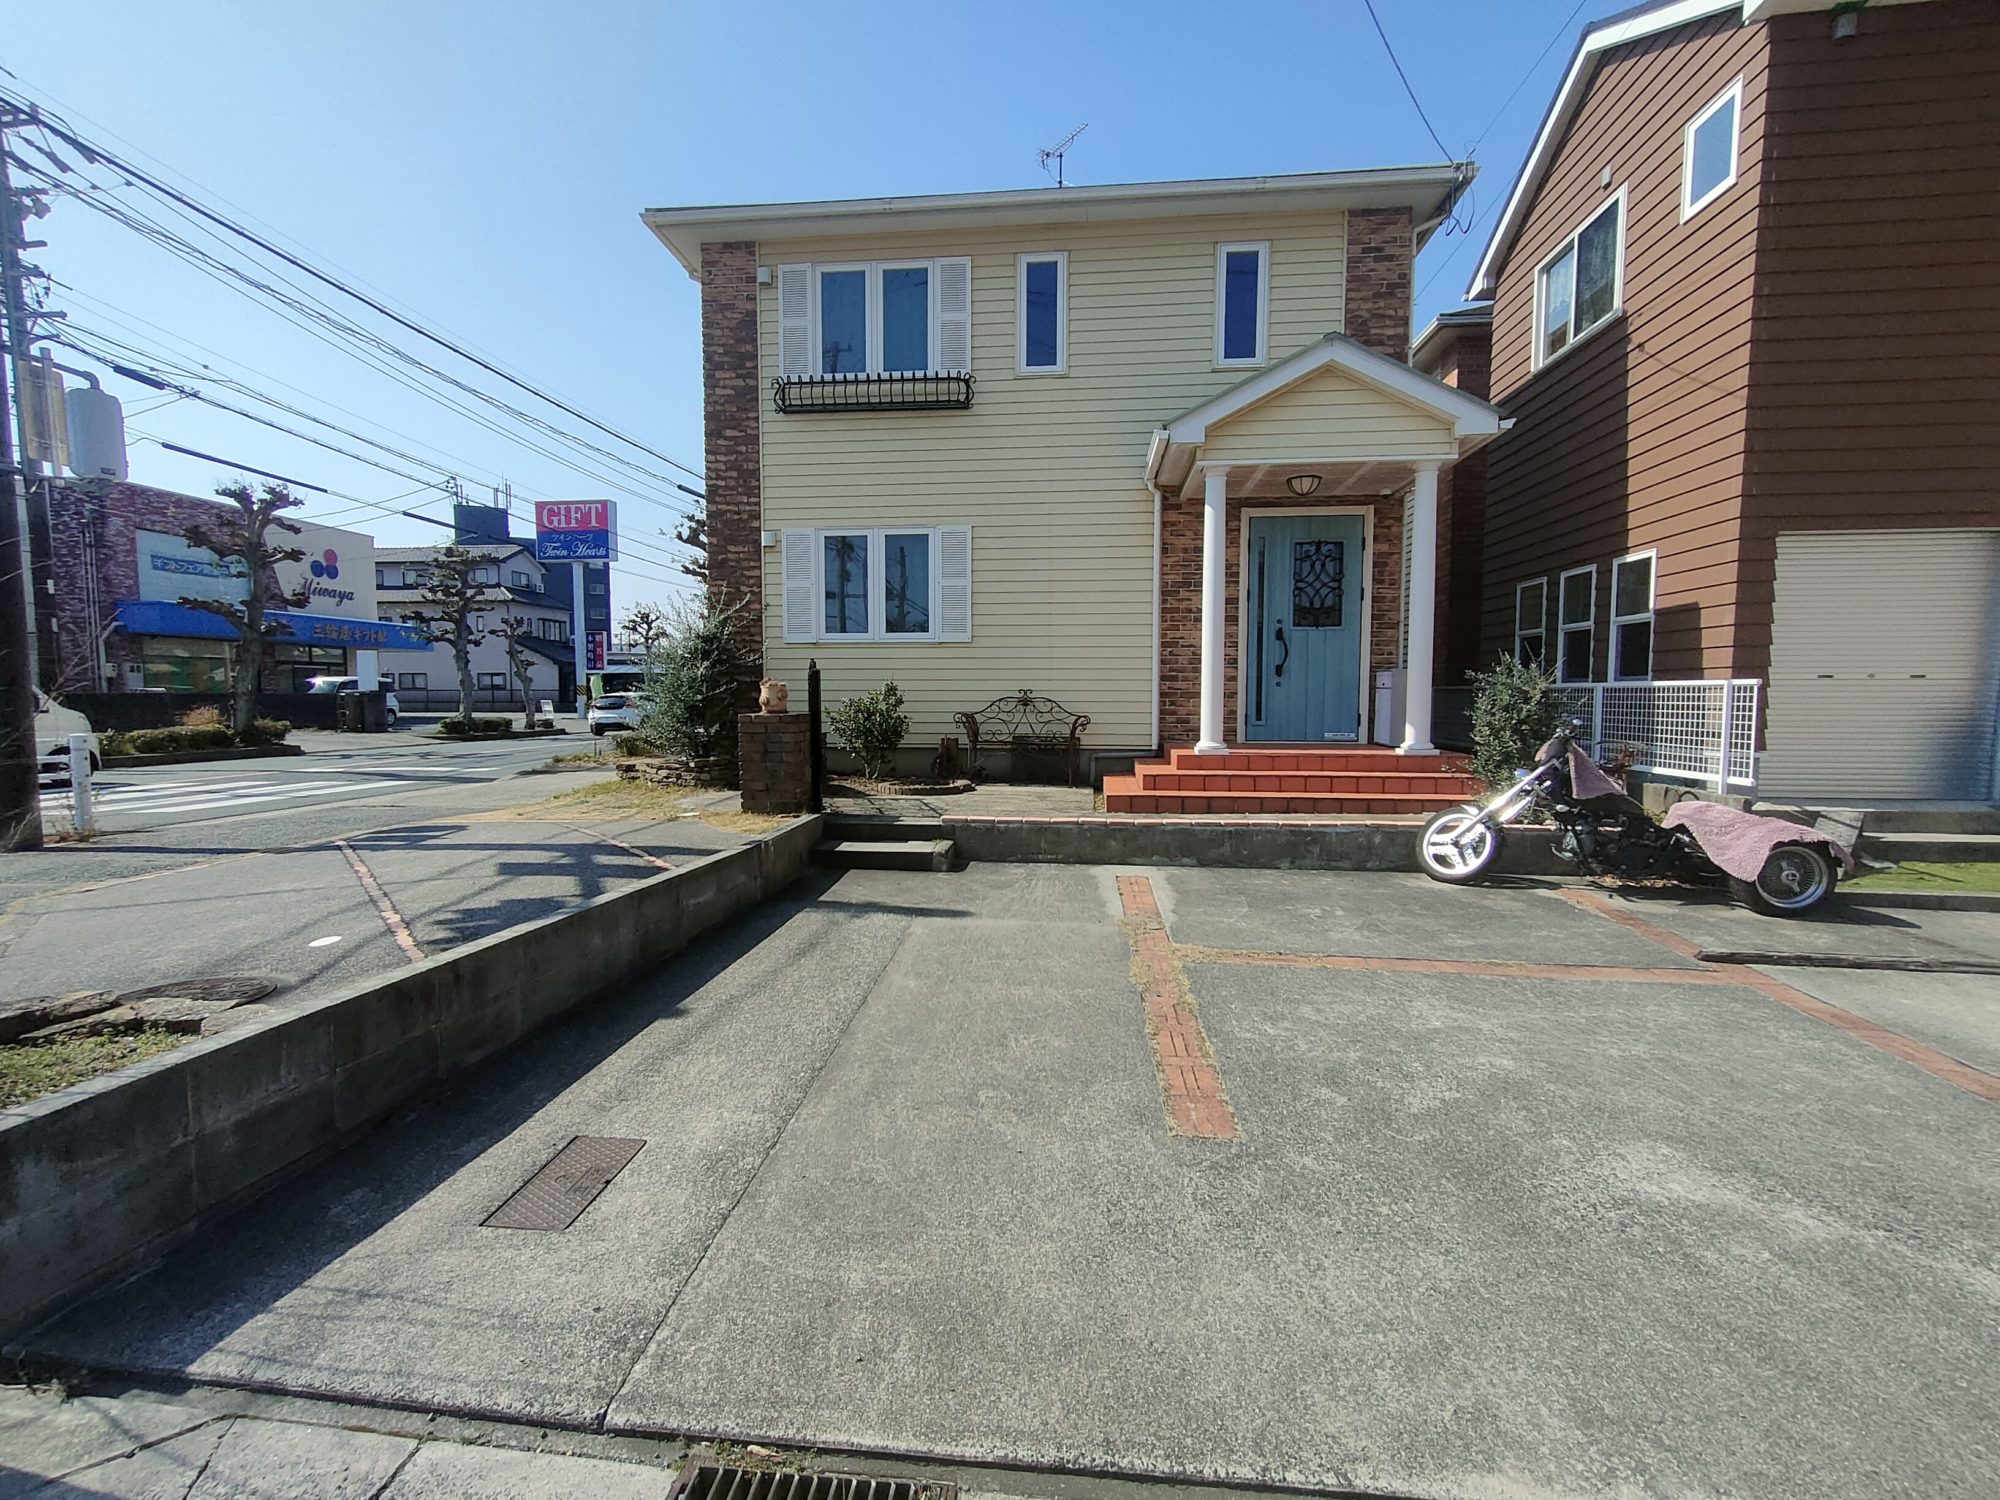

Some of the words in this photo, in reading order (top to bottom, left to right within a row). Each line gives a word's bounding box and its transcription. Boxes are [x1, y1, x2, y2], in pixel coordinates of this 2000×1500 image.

[542, 504, 602, 528] GIFT
[540, 542, 568, 557] Twin
[570, 541, 607, 557] Hearts
